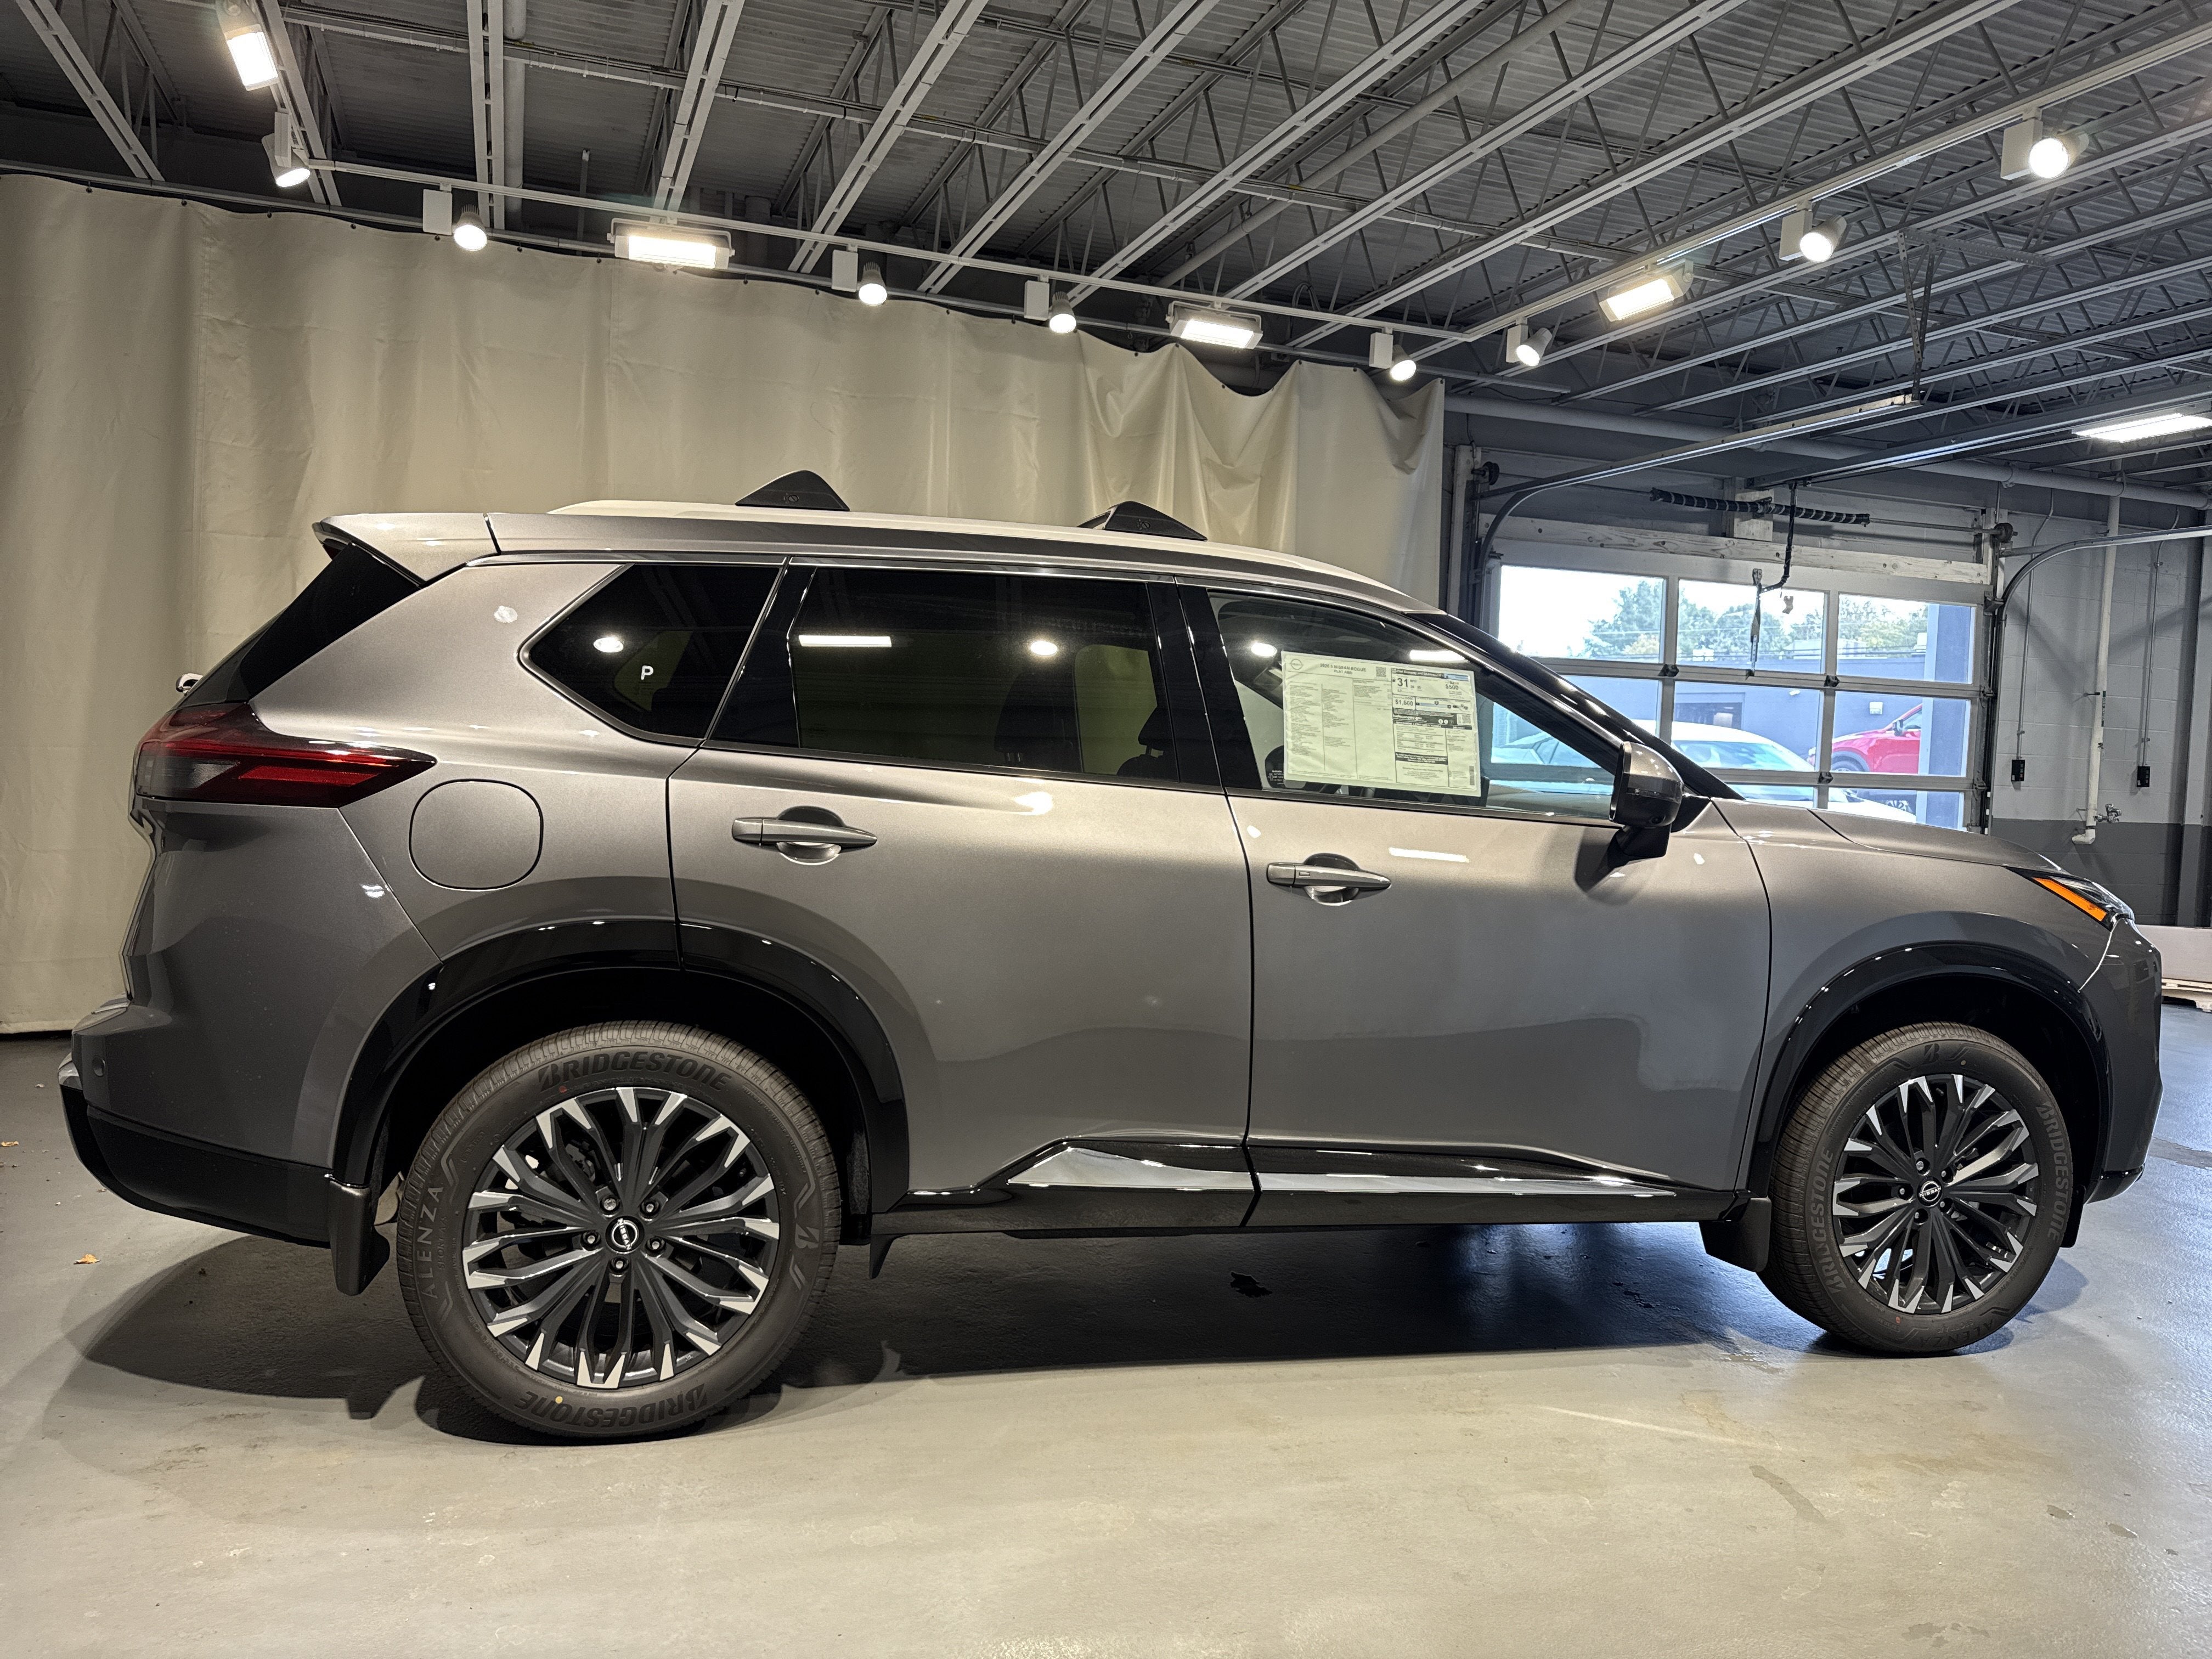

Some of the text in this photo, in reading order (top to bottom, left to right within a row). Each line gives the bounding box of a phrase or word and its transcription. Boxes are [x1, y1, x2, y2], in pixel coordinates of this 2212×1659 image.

[641, 665, 654, 680] P
[1397, 678, 1408, 688] 31
[538, 1051, 732, 1092] BRIDGESTONE
[2035, 1101, 2069, 1244] BRIDGESTONE
[1918, 1185, 1942, 1198] NISSAN
[617, 1217, 632, 1250] NISSAN
[1810, 1146, 1847, 1293] BRIDGESTONE
[417, 1186, 444, 1299] ALENZA
[1924, 1319, 1993, 1344] ALENZA
[514, 1383, 708, 1428] BRIDGESTONE
